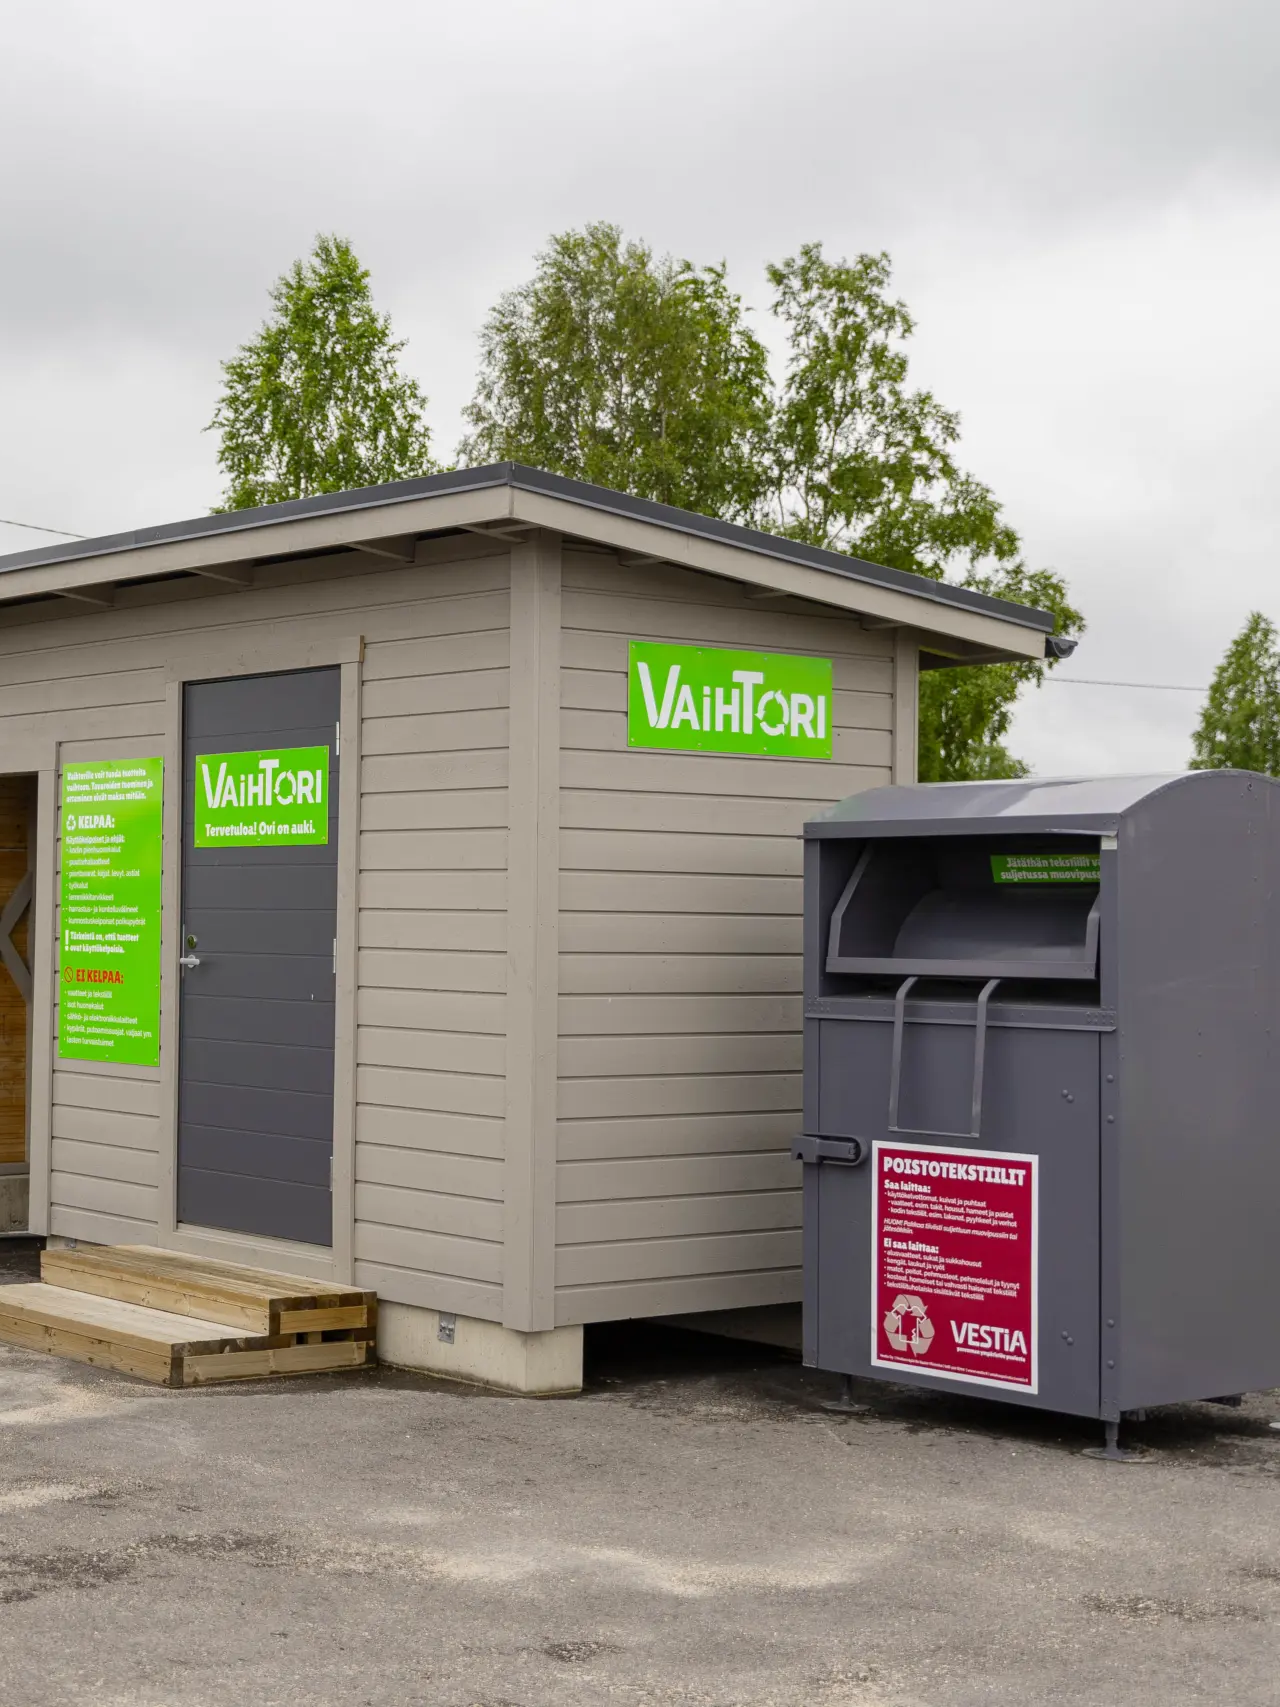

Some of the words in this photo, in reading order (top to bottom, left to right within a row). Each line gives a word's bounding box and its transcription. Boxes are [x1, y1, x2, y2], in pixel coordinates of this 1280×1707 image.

[95, 770, 105, 778] voit
[106, 769, 122, 778] tuoda
[122, 768, 146, 777] tuotteita
[91, 781, 120, 790] Tavaroiden
[122, 780, 147, 789] tuominen
[147, 779, 153, 789] ja
[94, 793, 107, 801] eivät
[108, 792, 125, 800] maksa
[78, 814, 115, 829] KELPAA:
[205, 822, 257, 837] Tervetuloa!
[258, 821, 275, 835] Ovi
[278, 824, 289, 835] on
[291, 820, 316, 834] auki.
[1007, 857, 1049, 868] Jätäthän
[1050, 857, 1090, 867] tekstiilit
[1001, 870, 1048, 881] suljetussa
[94, 906, 98, 914] ja
[70, 931, 94, 940] Tärkeintä
[105, 932, 116, 940] että
[76, 969, 85, 982] EI
[87, 969, 124, 984] KELPAA:
[83, 1014, 88, 1022] ja
[884, 1156, 1026, 1186] POISTOTEKSTIILIT
[884, 1179, 899, 1189] Saa
[900, 1181, 931, 1193] laittaa:
[939, 1196, 956, 1204] kuivat
[957, 1198, 963, 1206] ja
[964, 1199, 986, 1208] puhtaat
[966, 1207, 988, 1216] hameet
[988, 1209, 994, 1217] ja
[995, 1211, 1014, 1219] paidat
[992, 1218, 998, 1226] ja
[998, 1220, 1017, 1228] verhot
[884, 1238, 892, 1248] Ei
[892, 1241, 907, 1250] saa
[908, 1241, 939, 1254] laittaa:
[908, 1260, 925, 1268] laukut
[945, 1256, 982, 1268] sukkahousut
[968, 1284, 992, 1294] haisevat
[1001, 1280, 1020, 1290] tyynyt
